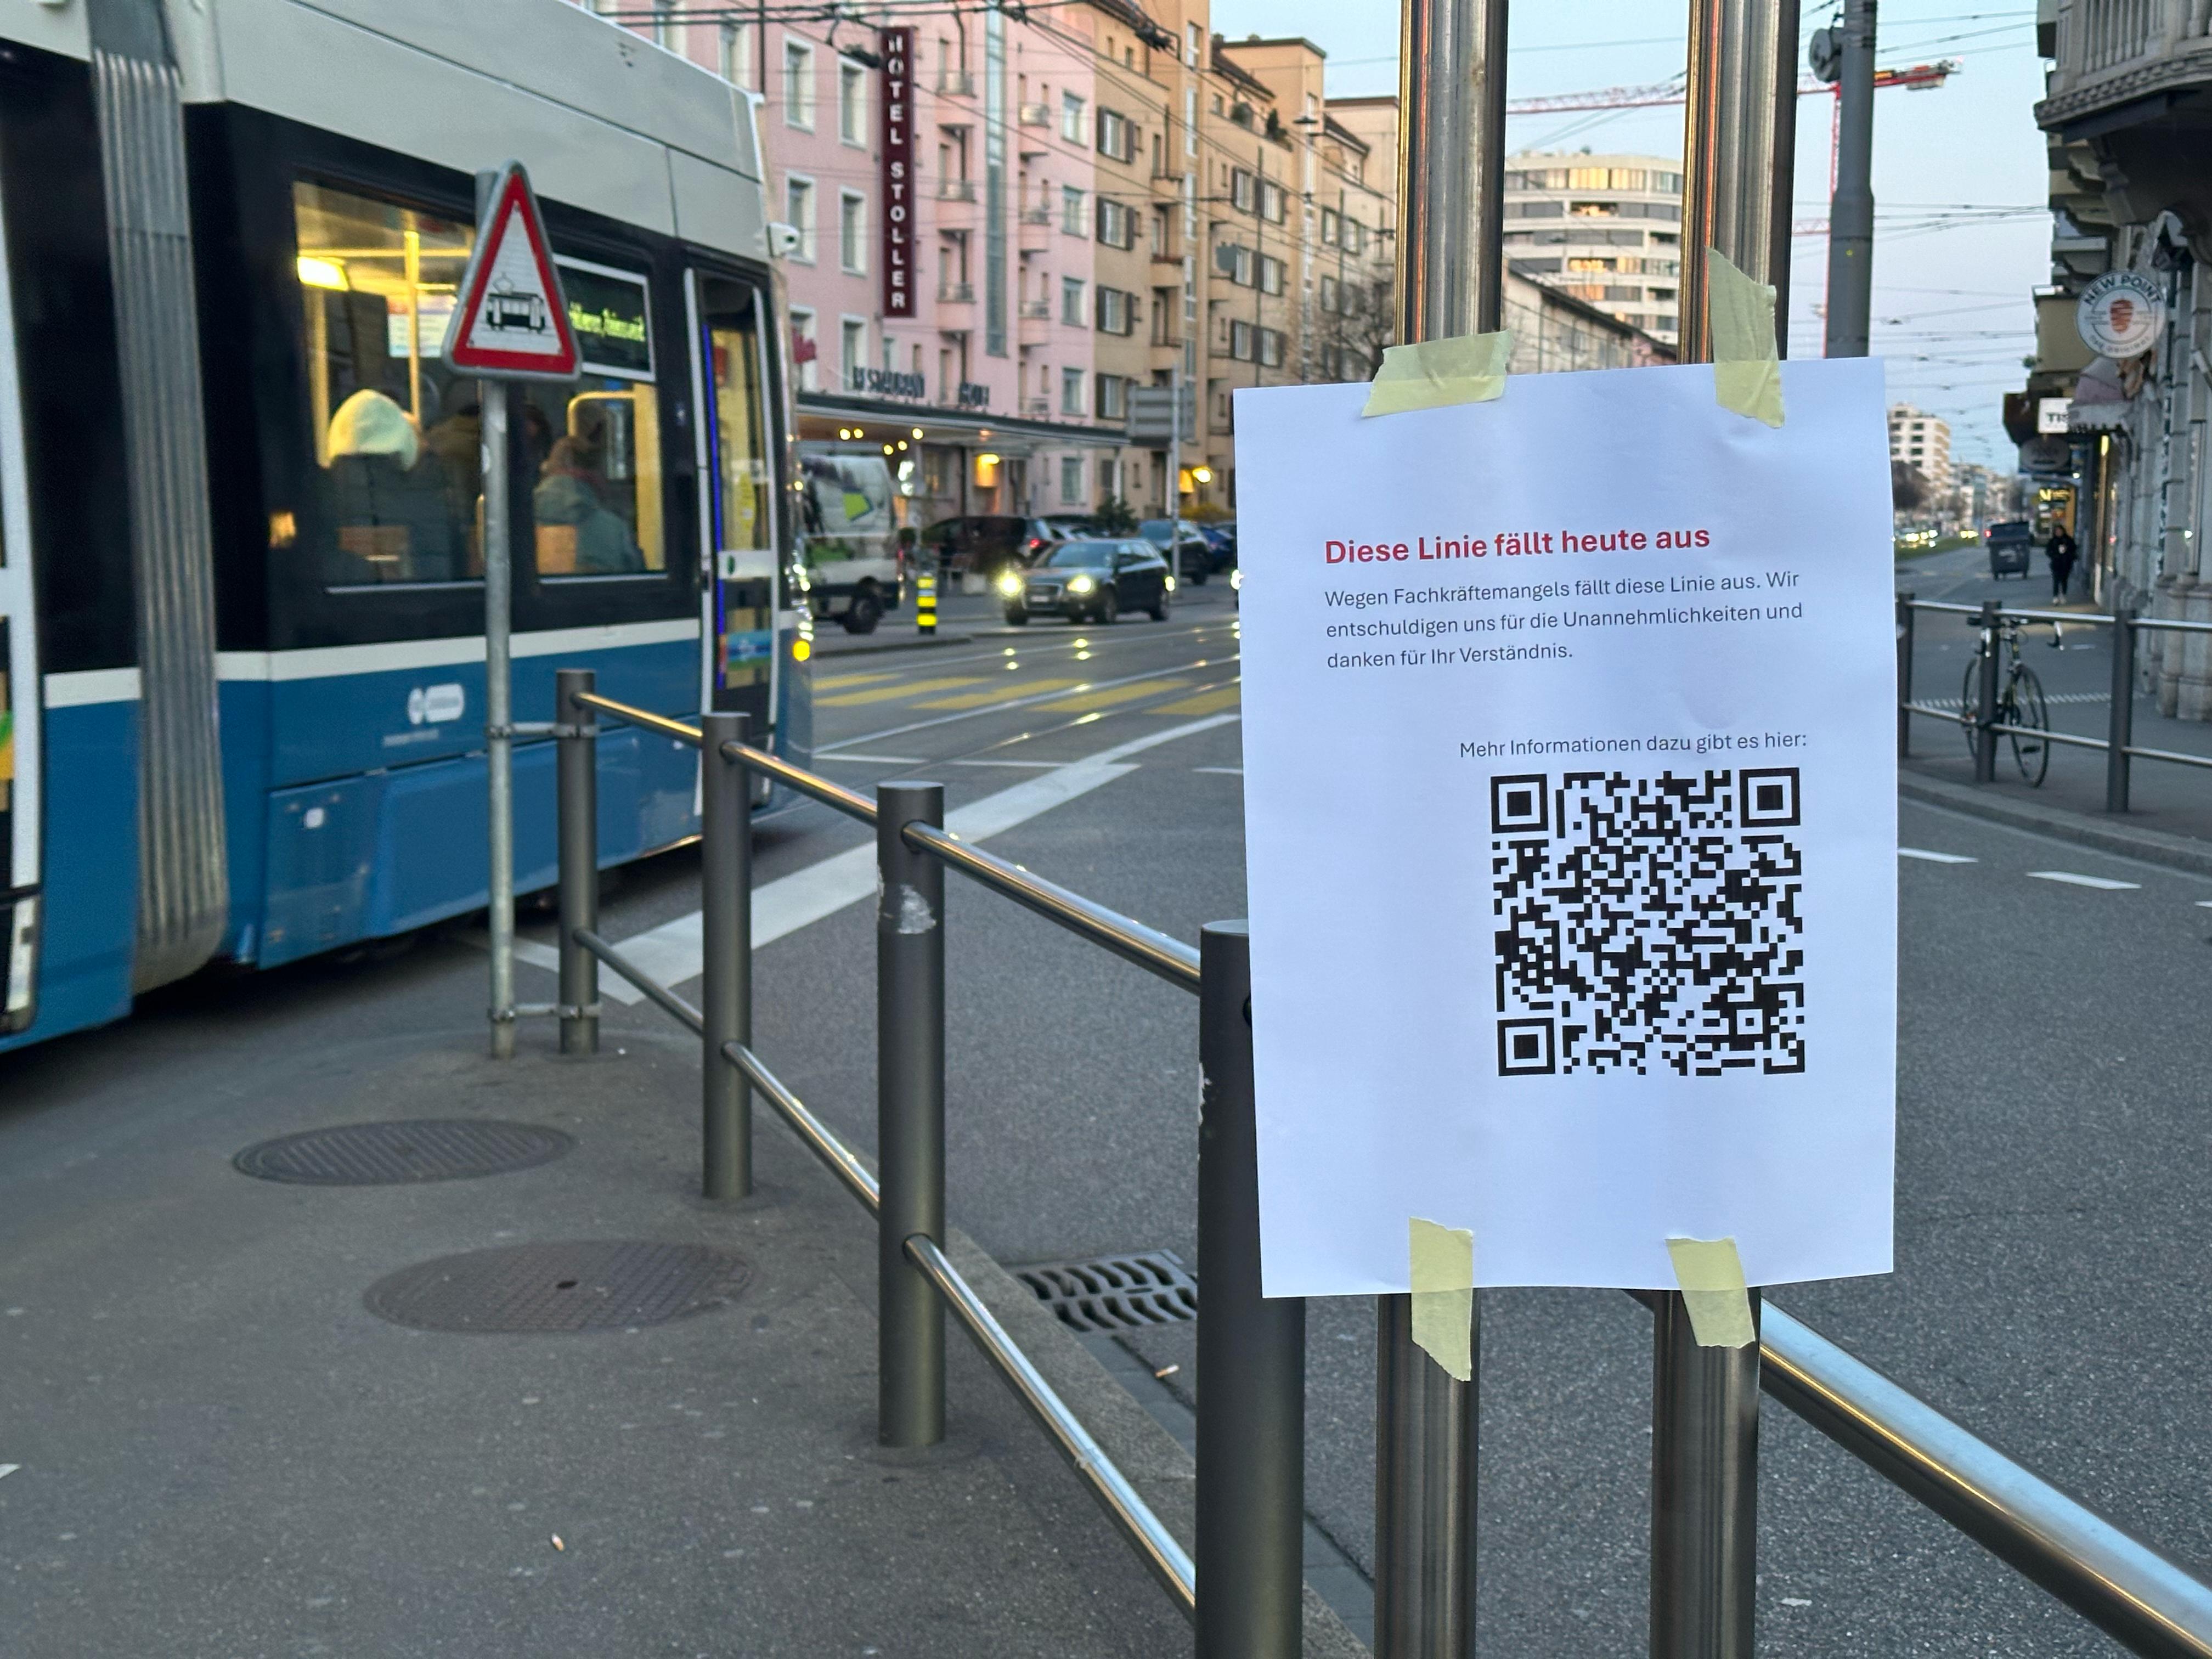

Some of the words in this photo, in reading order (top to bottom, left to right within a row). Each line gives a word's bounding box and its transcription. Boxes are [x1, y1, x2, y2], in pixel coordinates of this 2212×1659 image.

[888, 35, 904, 145] HOTEL
[889, 161, 906, 309] STOLLER
[2084, 277, 2116, 305] NEW
[2121, 275, 2161, 302] POINT
[1325, 539, 1409, 564] Diese
[1418, 534, 1487, 560] Linie
[1494, 531, 1554, 557] fällt
[1562, 529, 1647, 554] heute
[1656, 529, 1710, 550] aus
[1324, 590, 1388, 610] Wegen
[1394, 581, 1570, 605] Fachkräftemangels
[1575, 579, 1611, 596] fällt
[1615, 578, 1664, 594] diese
[1671, 575, 1715, 592] Linie
[1720, 577, 1760, 590] aus.
[1765, 571, 1799, 588] Wir
[1327, 618, 1458, 638] entschuldigen
[1464, 618, 1496, 632] uns
[1500, 614, 1525, 630] für
[1530, 612, 1558, 629] die
[1564, 605, 1760, 627] Unannehmlichkeiten
[1767, 602, 1802, 619] und
[1327, 651, 1395, 668] danken
[1400, 650, 1426, 665] für
[1431, 648, 1455, 664] Ihr
[1459, 642, 1573, 663] Verständnis.
[1460, 741, 1506, 758] Mehr
[1510, 736, 1641, 755] Informationen
[1646, 735, 1691, 751] dazu
[1696, 733, 1732, 754] gibt
[1737, 736, 1759, 749] es
[1765, 731, 1807, 748] hier:
